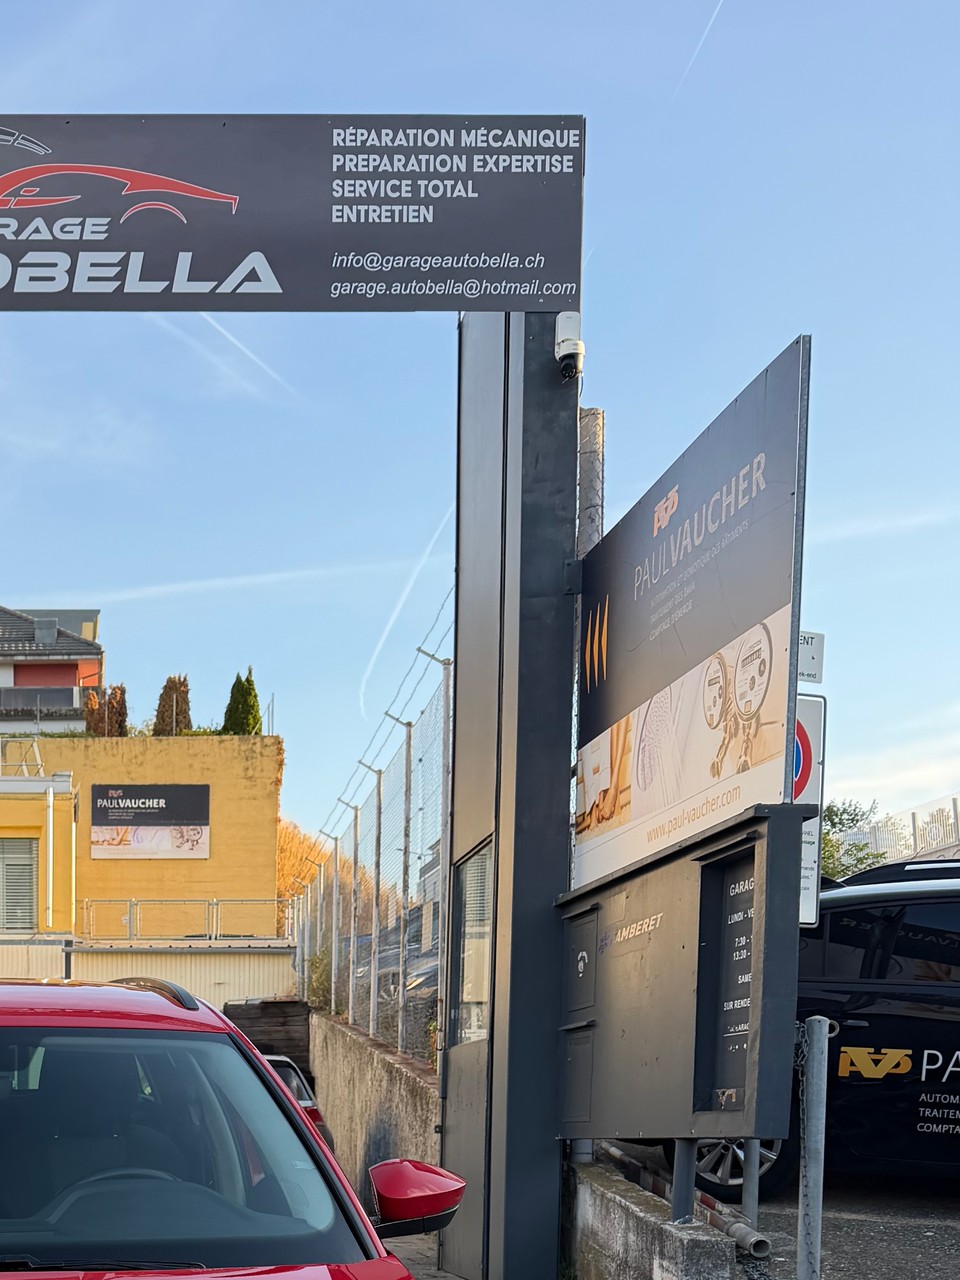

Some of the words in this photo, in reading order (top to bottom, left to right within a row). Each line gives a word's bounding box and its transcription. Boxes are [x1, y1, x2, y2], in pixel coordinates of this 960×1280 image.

[332, 126, 455, 148] RÉPARATION
[460, 126, 581, 150] MÉCANIQUE
[332, 153, 467, 173] PREPARATION
[473, 154, 574, 174] EXPERTISE
[332, 179, 412, 198] SERVICE
[417, 179, 479, 198] TOTAL
[331, 204, 434, 223] ENTRETIEN
[332, 251, 545, 272] info@garageautobella.ch
[330, 278, 577, 299] garage.autobella@hotmail.com
[646, 785, 741, 844] www.paul-vaucher.com
[615, 912, 664, 943] AMBERET
[921, 1049, 960, 1083] PA
[919, 1092, 960, 1104] AUTOM
